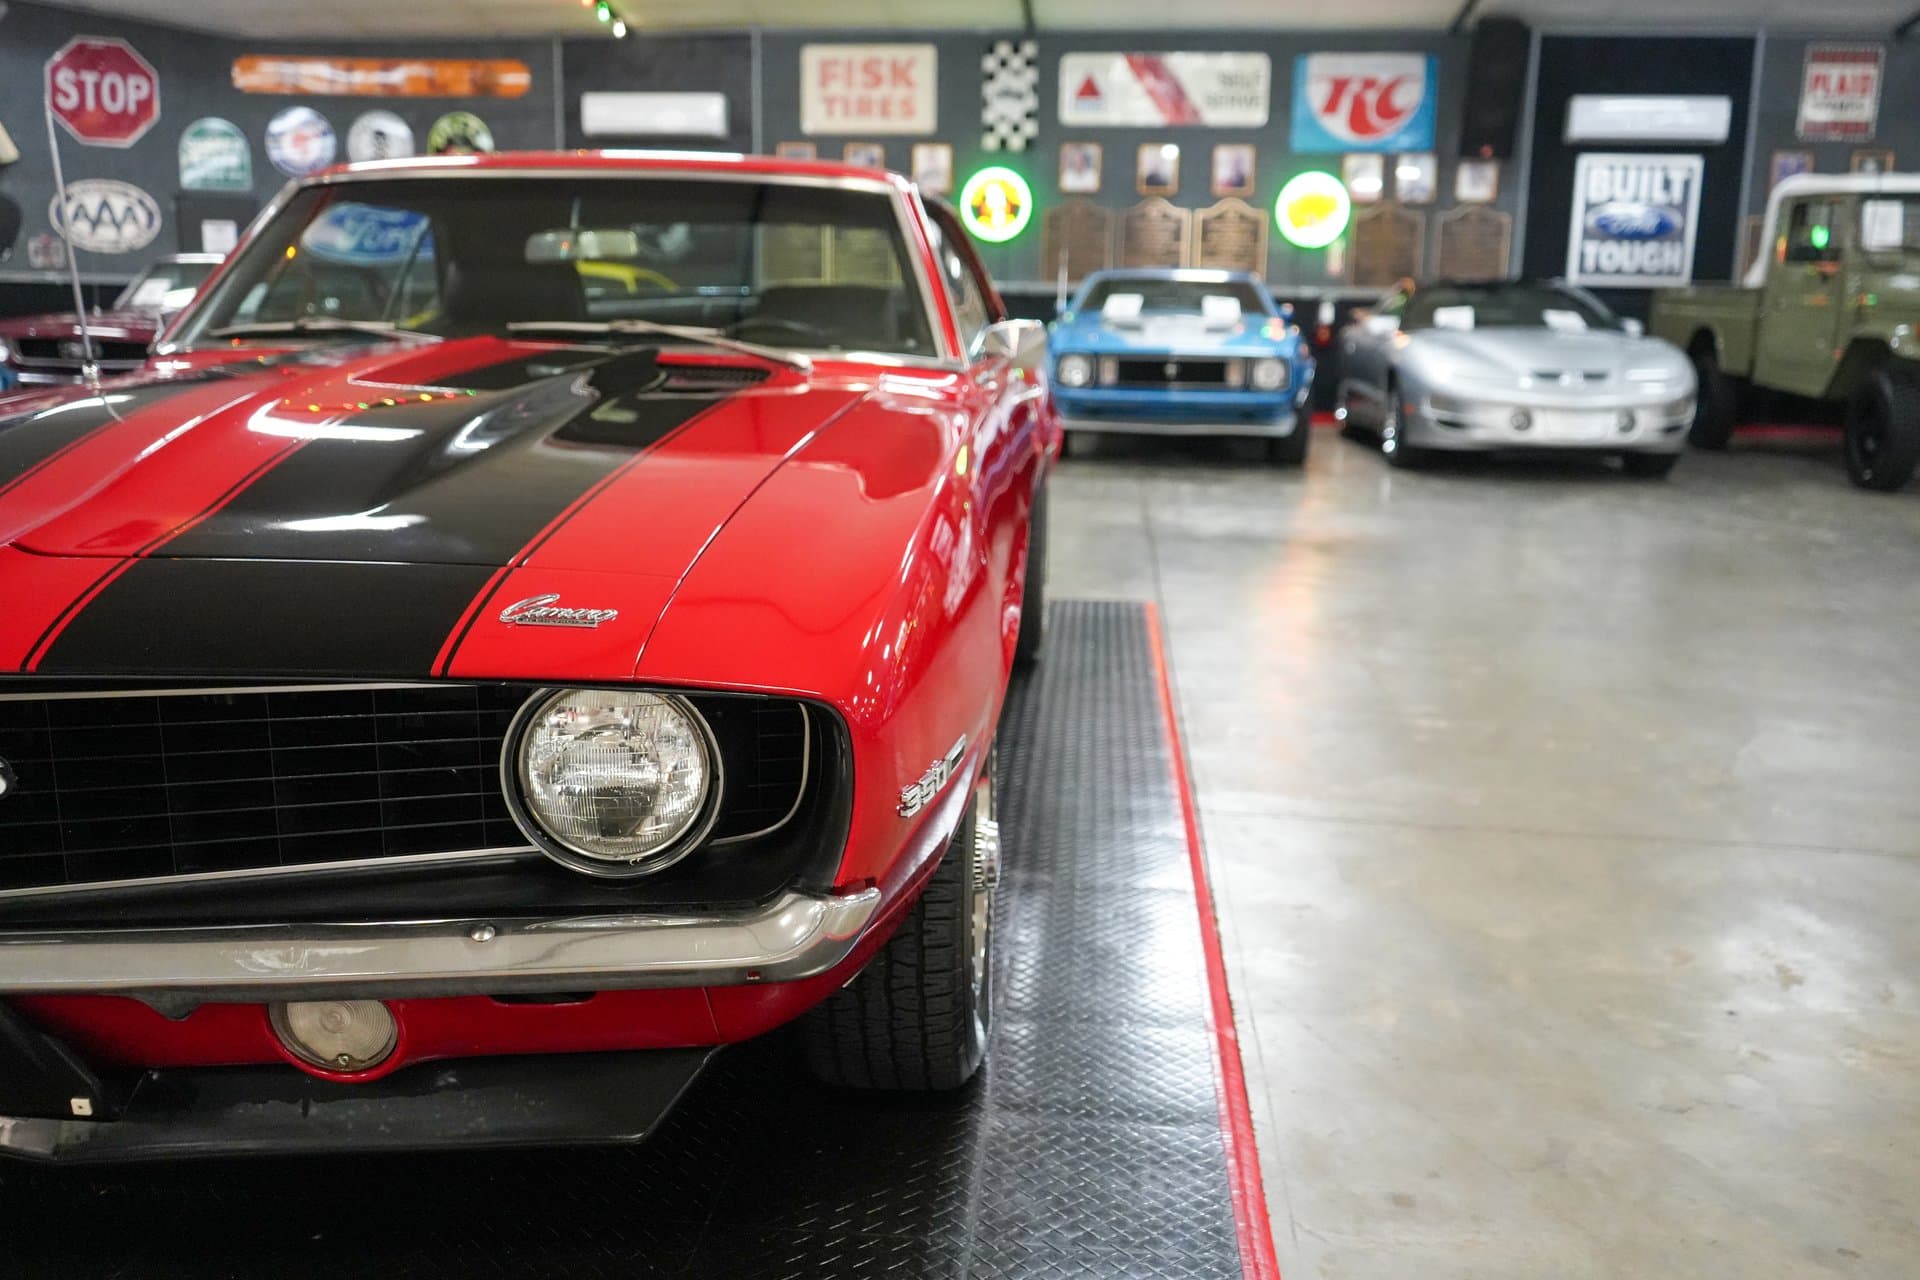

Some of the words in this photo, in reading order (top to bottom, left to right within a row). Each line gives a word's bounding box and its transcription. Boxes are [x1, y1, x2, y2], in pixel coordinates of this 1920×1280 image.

[55, 66, 151, 115] STOP
[818, 57, 918, 89] FISK
[823, 95, 916, 119] TIRES
[1315, 76, 1414, 137] RC
[1587, 166, 1692, 204] BUILT
[68, 197, 141, 237] AAA
[1580, 240, 1684, 274] TOUGH
[499, 593, 618, 623] Camaro
